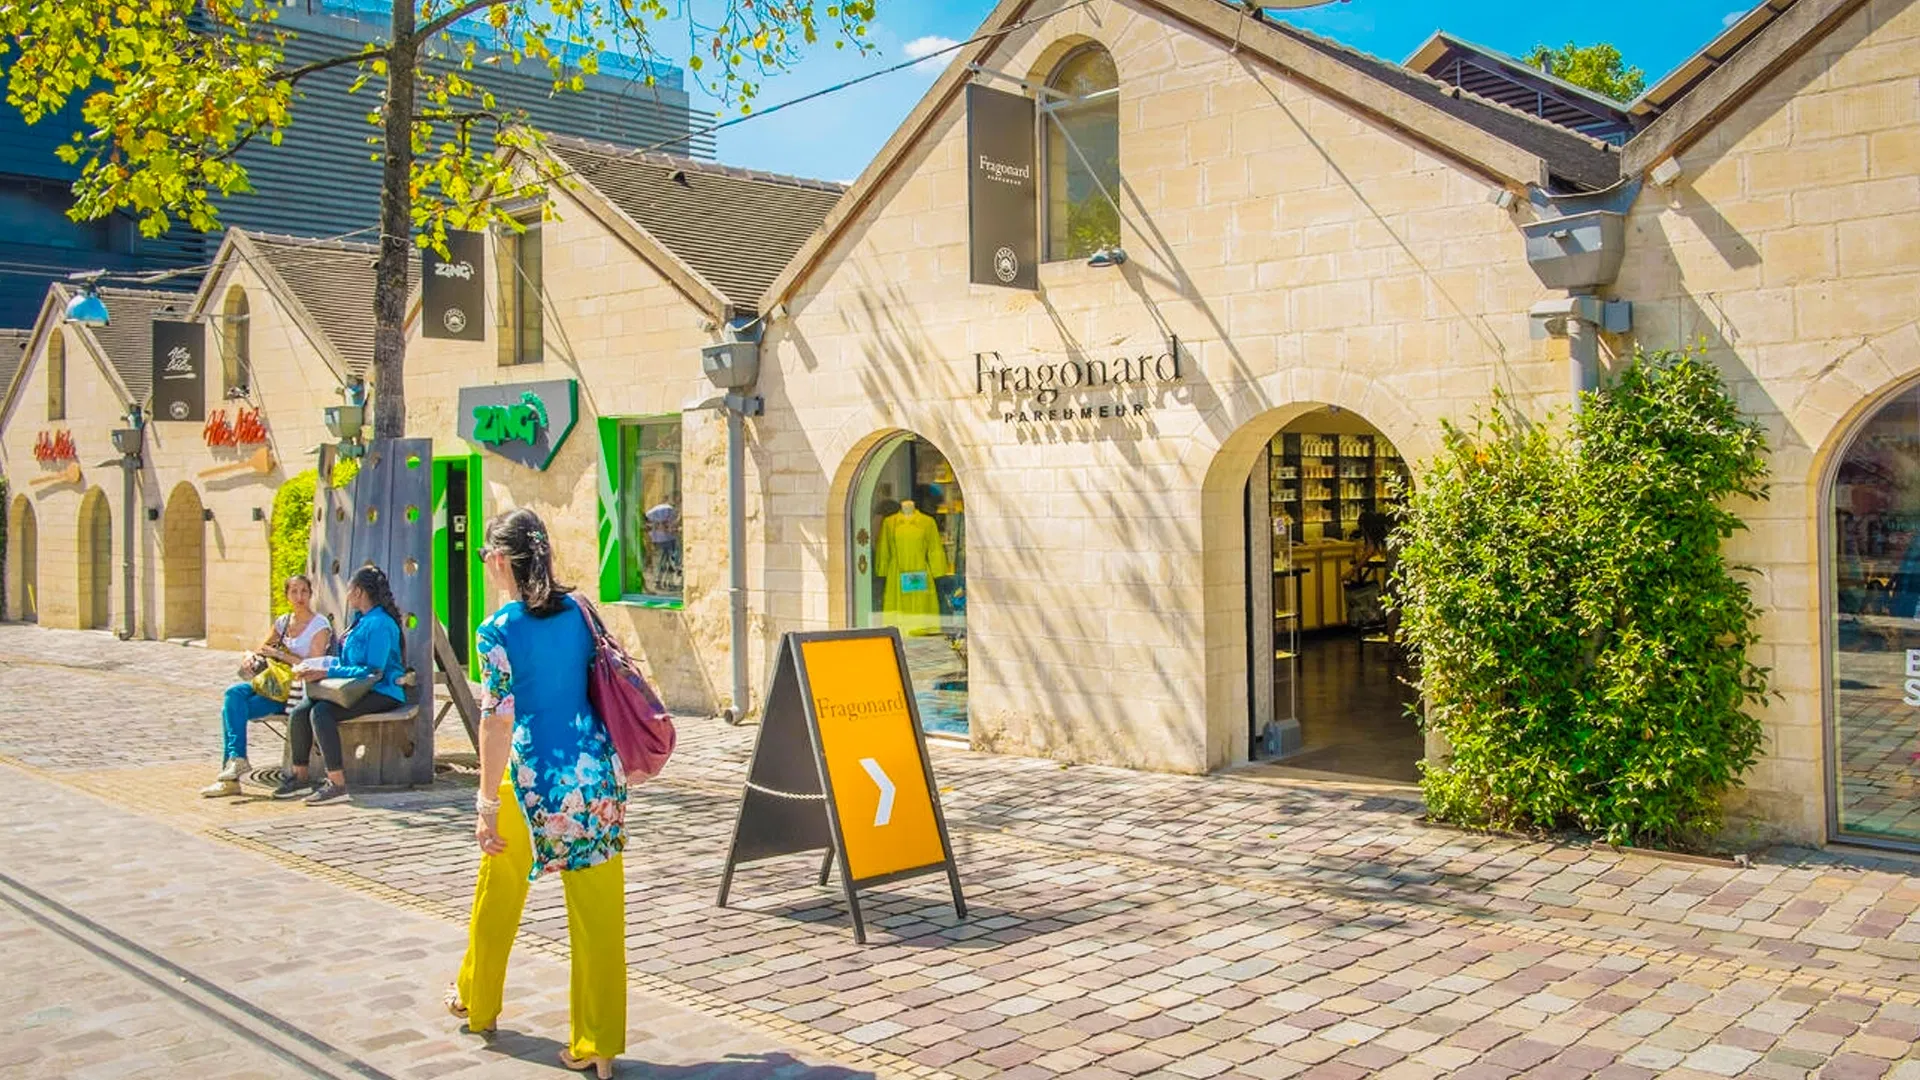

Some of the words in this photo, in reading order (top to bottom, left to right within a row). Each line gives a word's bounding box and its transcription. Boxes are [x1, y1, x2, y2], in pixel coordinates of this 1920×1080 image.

[980, 154, 1030, 177] Fragonard
[973, 334, 1184, 404] Fragonard
[472, 399, 538, 448] ZING
[1004, 404, 1145, 423] PARFUMEUR
[816, 691, 904, 722] Fragonard
